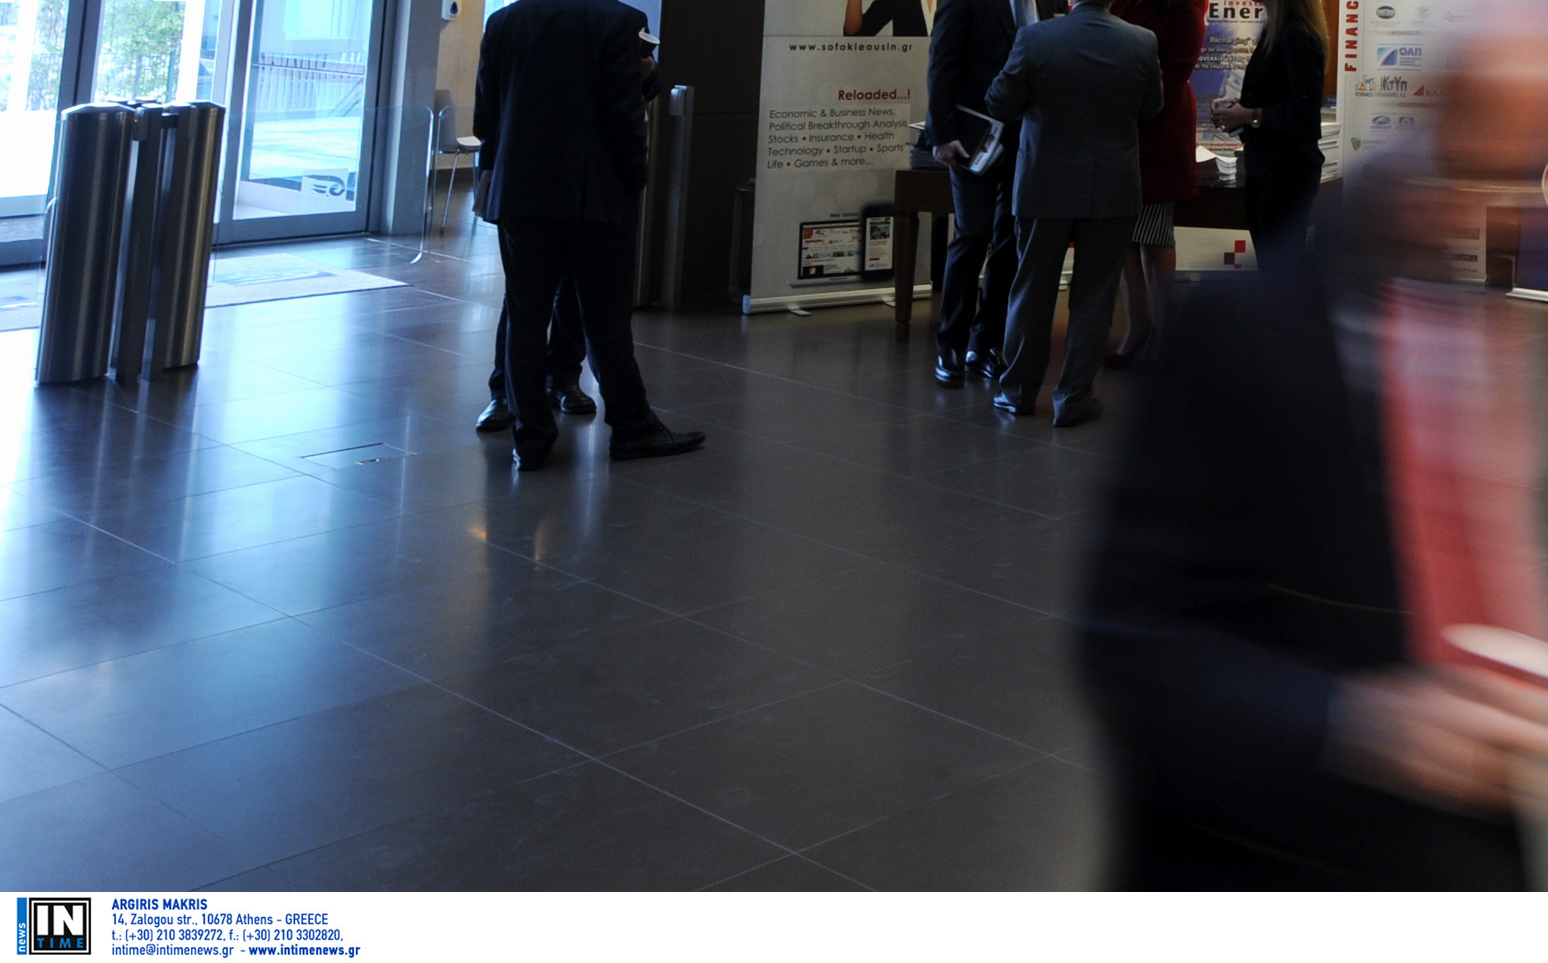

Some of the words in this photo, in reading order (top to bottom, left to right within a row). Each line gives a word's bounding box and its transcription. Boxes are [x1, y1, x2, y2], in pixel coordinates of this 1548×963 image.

[1209, 3, 1264, 19] Ener
[789, 42, 913, 54] www.sofokleousin.gr
[769, 109, 817, 119] Economic
[819, 109, 828, 117] &
[829, 108, 866, 117] Business
[769, 121, 806, 131] Political
[808, 120, 871, 131] Breakthrough
[768, 135, 799, 144] Stocks
[808, 133, 854, 143] Insurance
[864, 132, 895, 140] Health
[768, 147, 824, 157] Technology
[833, 145, 867, 155] Startup
[876, 144, 904, 153] Sports
[767, 160, 784, 169] Life
[794, 159, 829, 168] Games
[831, 158, 838, 166] &
